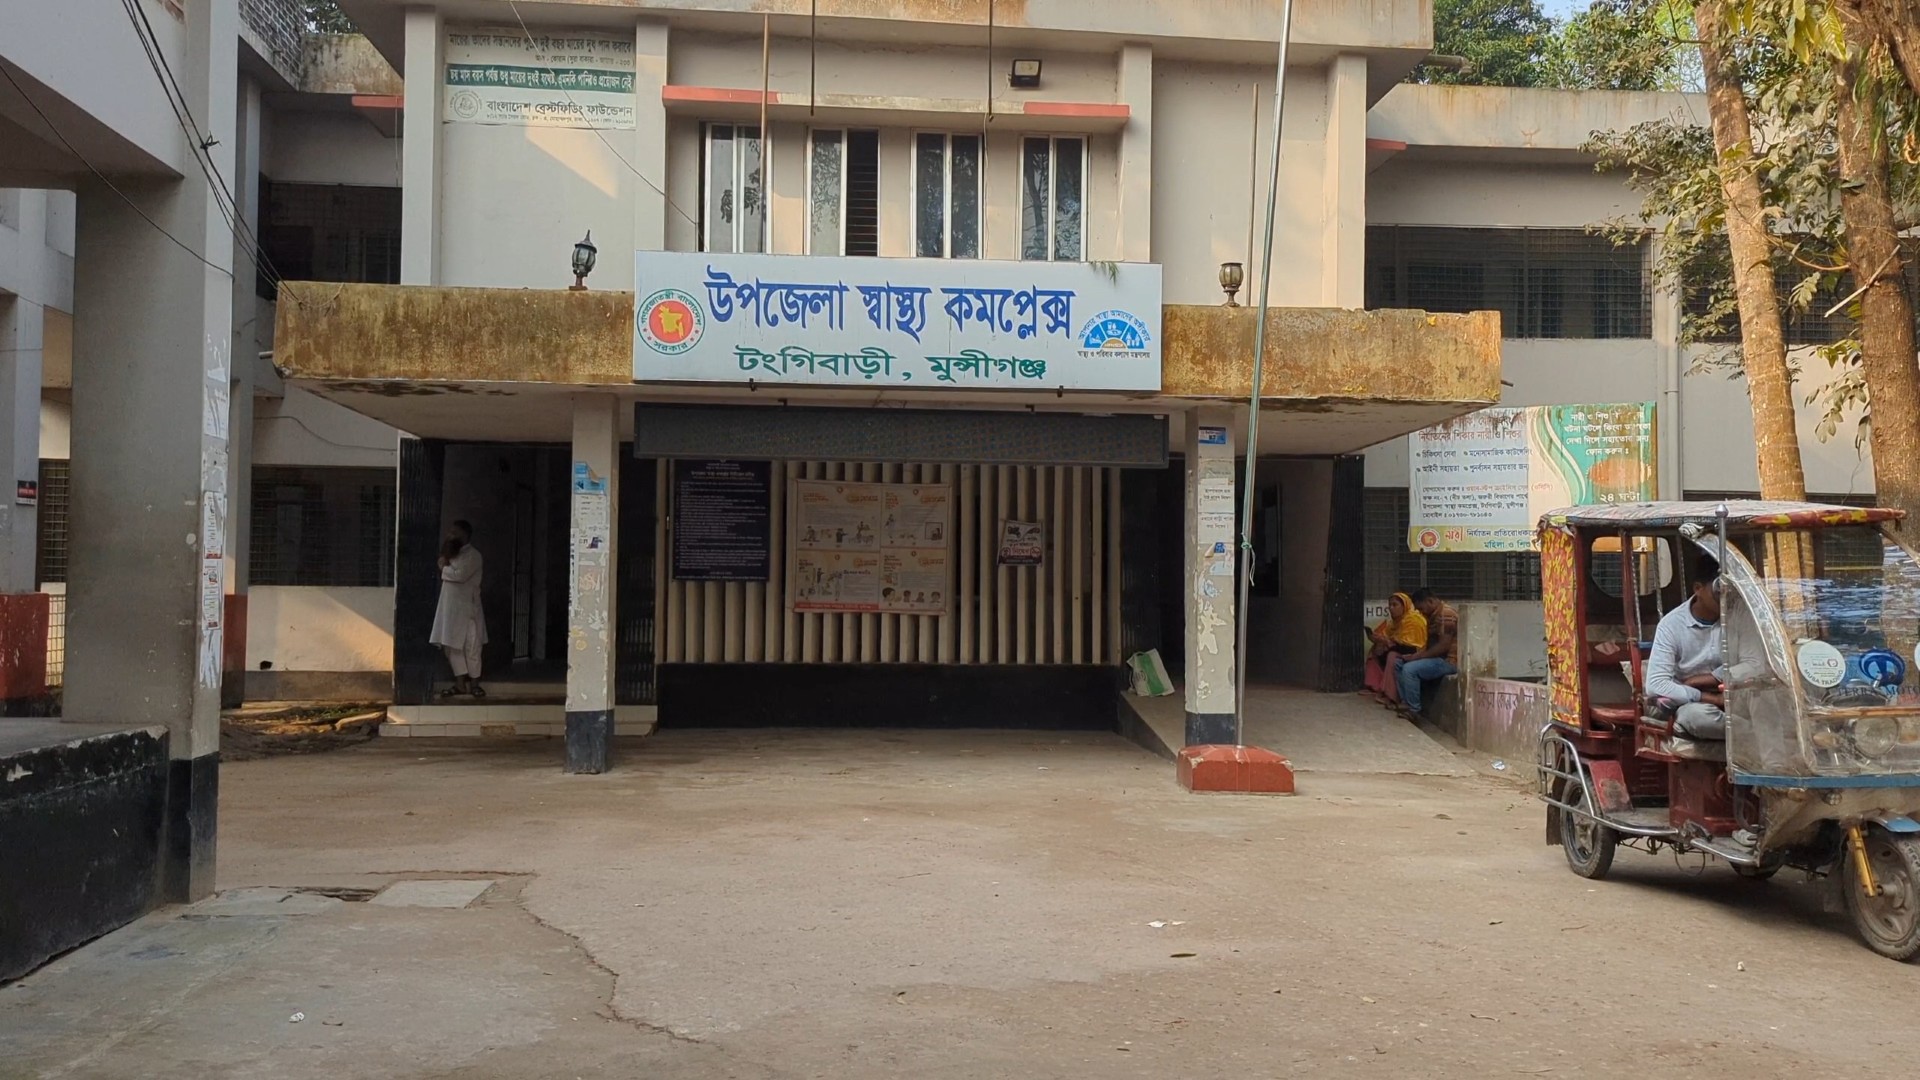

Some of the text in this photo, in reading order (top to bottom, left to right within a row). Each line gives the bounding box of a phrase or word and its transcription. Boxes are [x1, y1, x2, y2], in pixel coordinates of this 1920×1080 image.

[486, 101, 632, 117] বাংলাদেশ ব্রেস্টফিডিং ফাউন্ডেশন
[703, 264, 1076, 344] উপজেলা স্বাস্থ্য কমপ্লেক্স
[677, 294, 702, 326] বাংলাদেশ
[653, 340, 688, 352] সরকার
[925, 349, 1047, 383] মুন্সীগঞ্জ
[1454, 429, 1474, 441] শিকার
[1566, 437, 1581, 445] দেখা
[1444, 450, 1456, 458] সেবা
[1469, 448, 1504, 457] মনোসামাজিক
[1440, 465, 1459, 473] সহায়তা
[1470, 462, 1491, 473] পুনর্বাসন
[1600, 493, 1614, 502] ২৪
[1467, 528, 1491, 537] নির্যাতন
[1484, 540, 1505, 549] মহিলা
